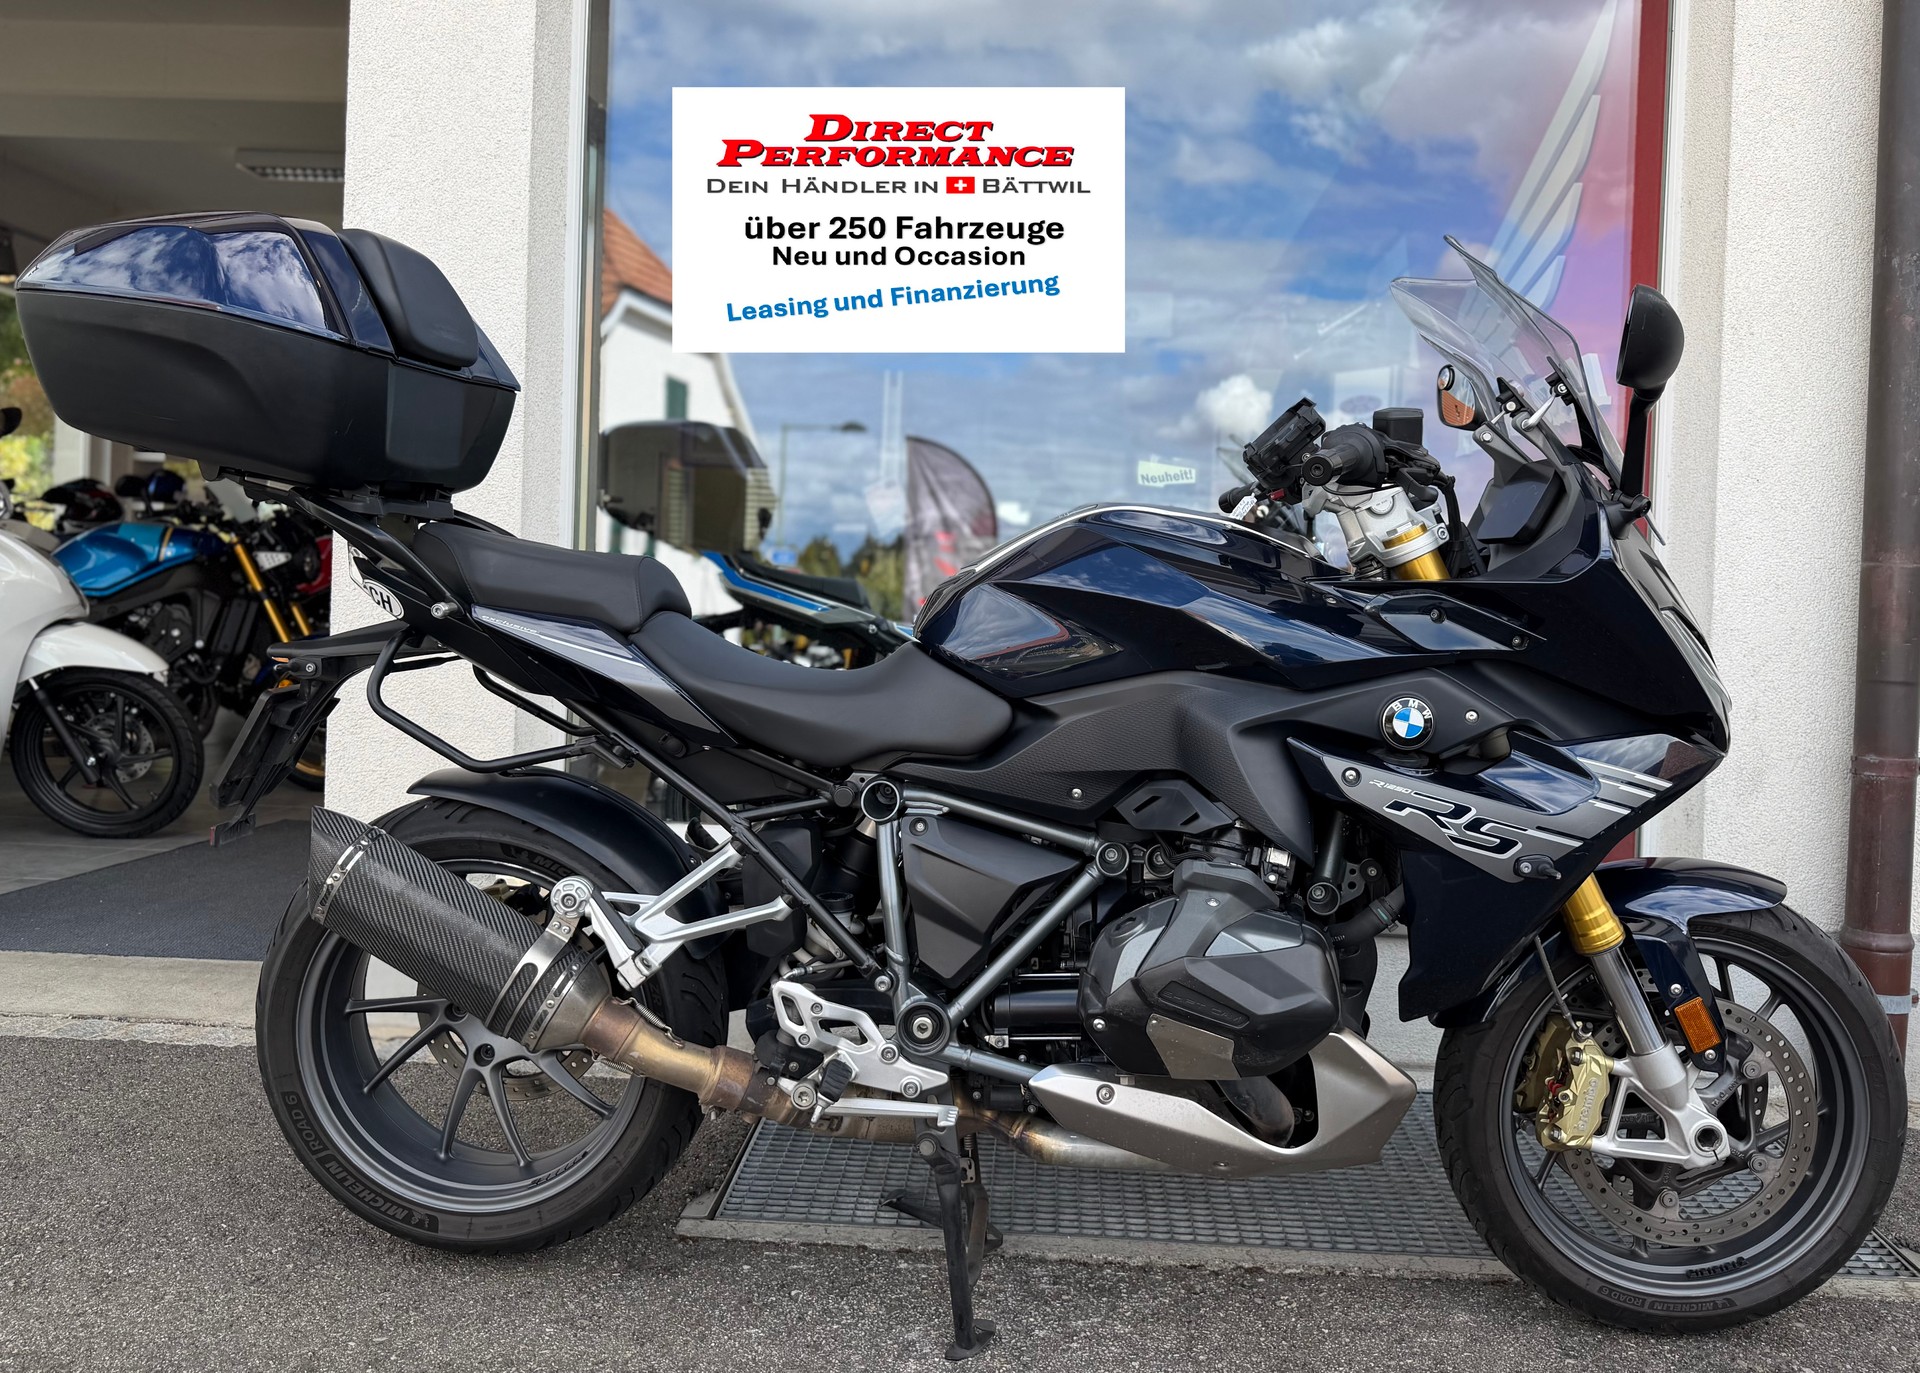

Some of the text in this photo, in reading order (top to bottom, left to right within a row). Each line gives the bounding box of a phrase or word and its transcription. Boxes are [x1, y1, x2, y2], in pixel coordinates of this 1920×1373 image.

[1140, 469, 1193, 484] Neuheit!
[369, 586, 393, 613] CH
[1391, 699, 1433, 720] BMW
[1383, 791, 1523, 859] RS
[1573, 1077, 1599, 1132] brembo
[286, 1095, 409, 1221] MICHELIN ROAD 6
[1610, 1290, 1642, 1307] ROAD
[1653, 1301, 1714, 1312] MICHELIN
